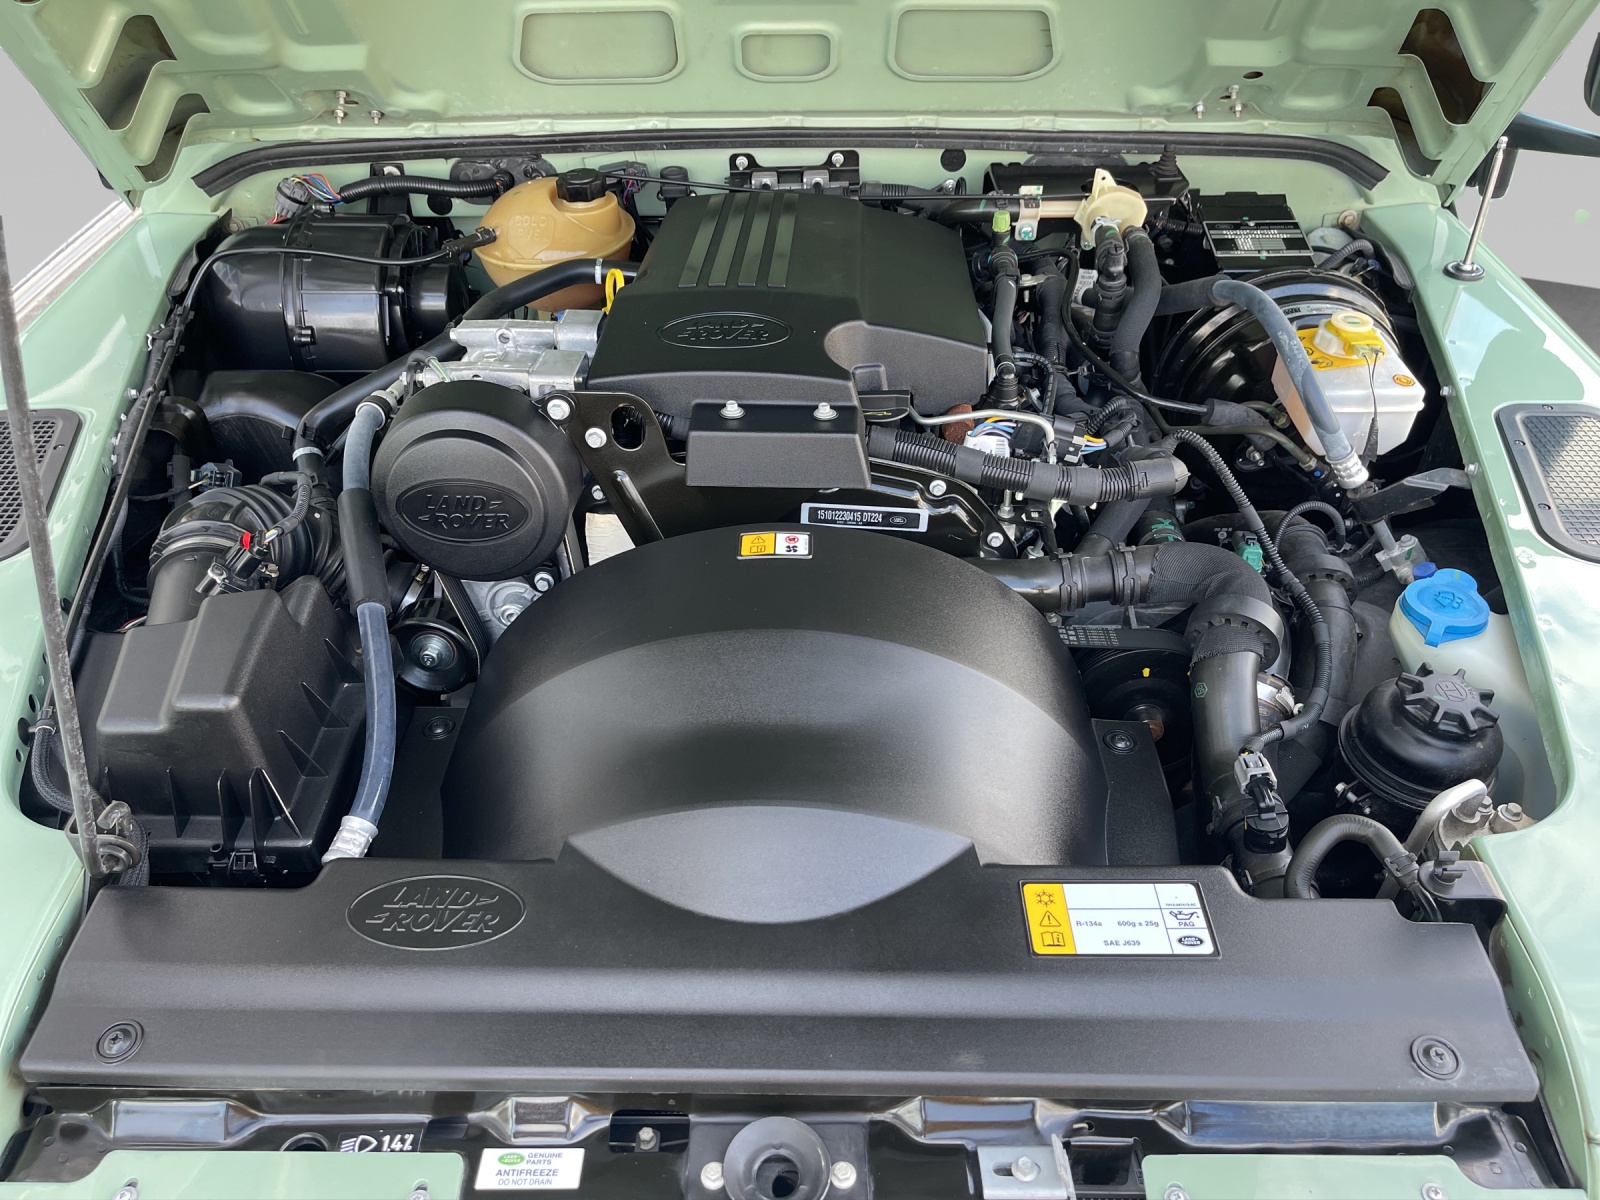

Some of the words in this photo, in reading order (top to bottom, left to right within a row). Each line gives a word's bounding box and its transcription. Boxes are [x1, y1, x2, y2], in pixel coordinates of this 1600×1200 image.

[514, 215, 547, 227] COLD
[689, 329, 769, 341] ROVER
[426, 494, 487, 511] LAND
[434, 512, 510, 531] ROVER
[862, 512, 883, 523] DT224
[382, 886, 478, 908] LAND
[382, 911, 500, 933] ROVER
[1117, 920, 1137, 928] 600g
[1144, 920, 1160, 928] 25g
[1103, 939, 1121, 947] SAE
[1122, 939, 1141, 947] J639
[495, 1168, 559, 1177] ANTIFREEZE
[498, 1178, 510, 1186] DO
[511, 1178, 528, 1186] NOT
[529, 1178, 553, 1186] DRAIN
